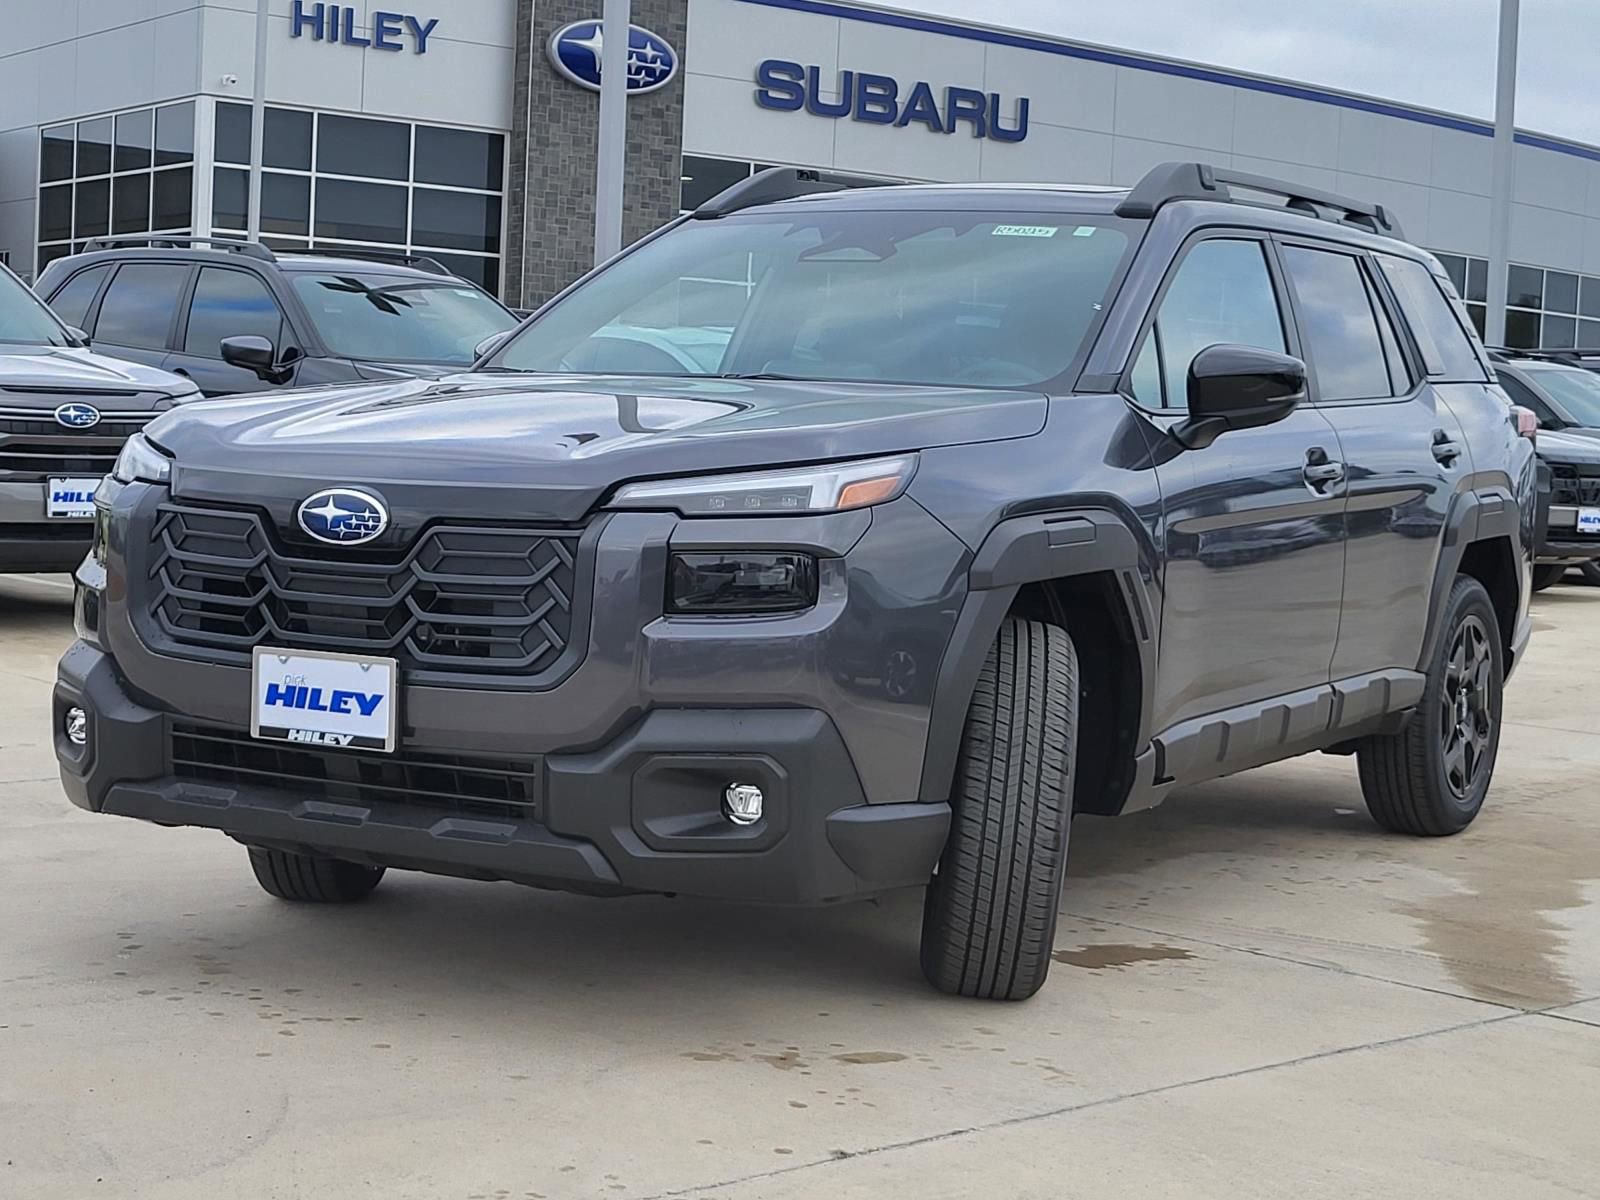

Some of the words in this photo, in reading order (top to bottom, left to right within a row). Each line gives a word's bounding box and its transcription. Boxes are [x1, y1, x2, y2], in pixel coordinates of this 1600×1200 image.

[290, 0, 439, 55] HILEY
[754, 59, 1030, 143] SUBARU
[53, 492, 95, 502] HILE
[265, 683, 384, 716] HILEY
[288, 729, 354, 746] HILEY
